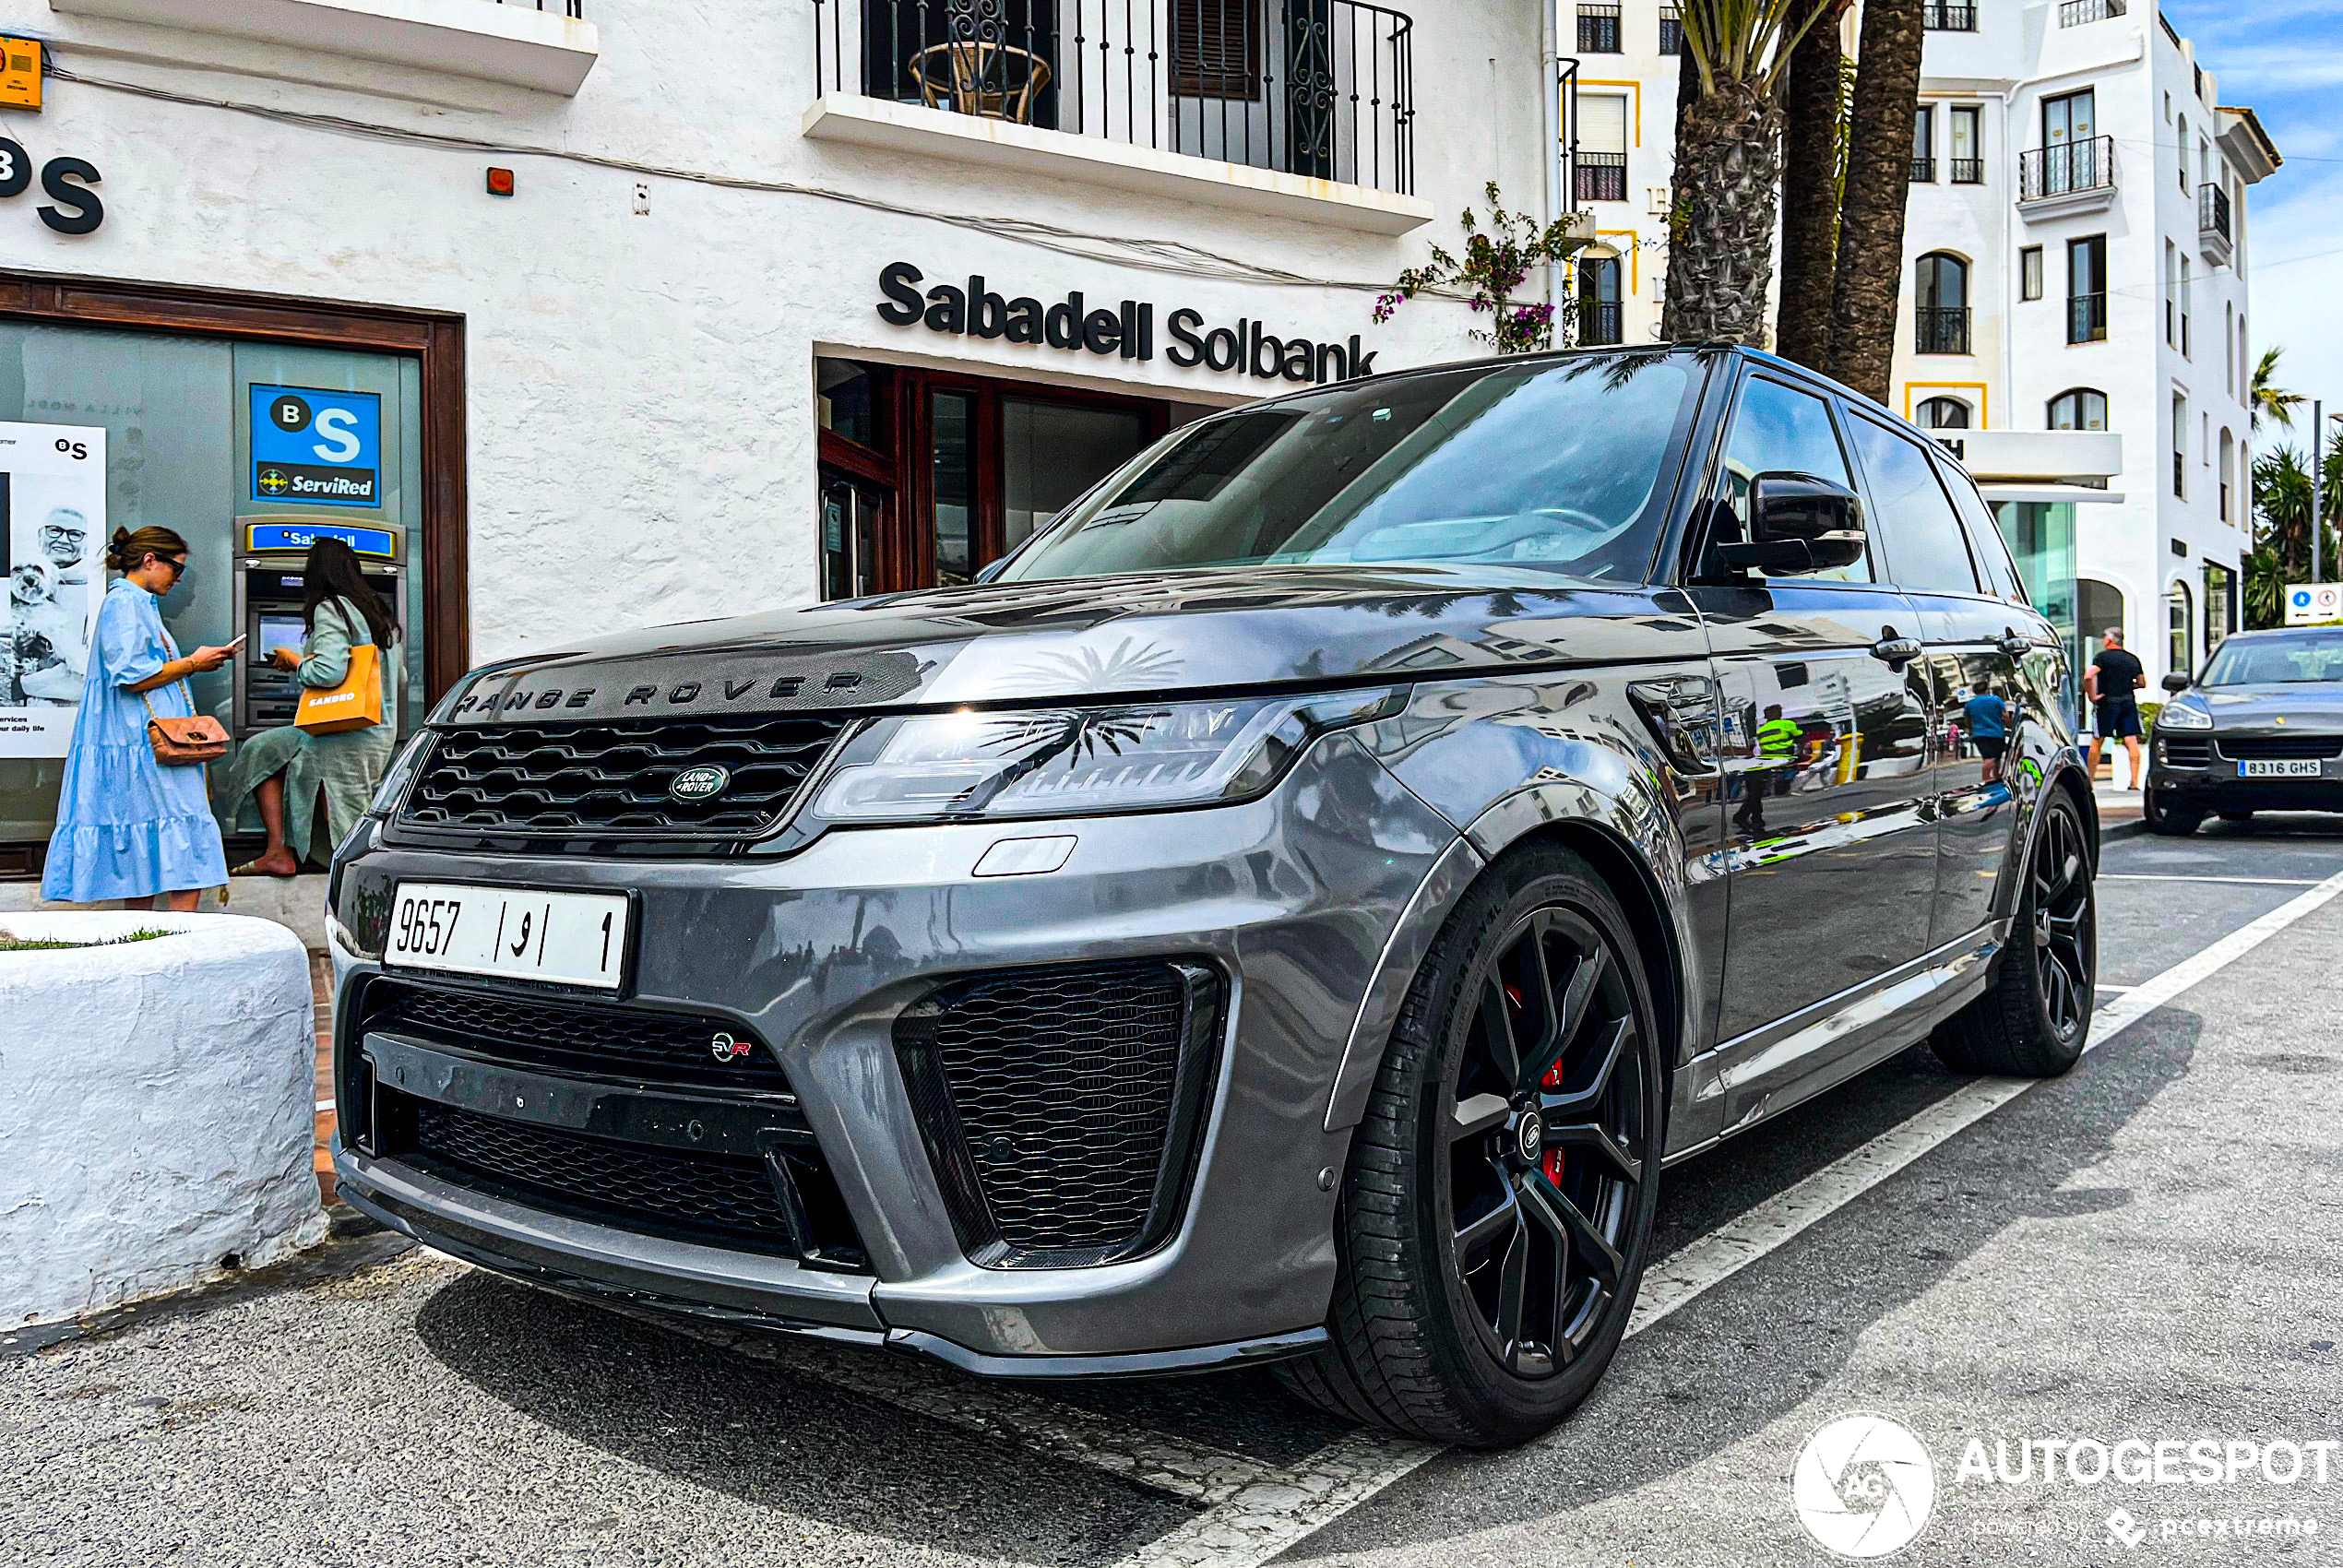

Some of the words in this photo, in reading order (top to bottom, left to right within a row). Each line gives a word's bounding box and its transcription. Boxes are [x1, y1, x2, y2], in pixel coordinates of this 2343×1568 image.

[876, 261, 1153, 361] Sabadell
[1165, 308, 1378, 385] Solbank
[291, 475, 372, 496] ServiRed
[309, 693, 355, 707] SANDRO
[456, 687, 596, 714] RANGE
[624, 671, 863, 707] ROVER
[681, 772, 710, 782] LAND
[2249, 763, 2285, 775] 8316
[2289, 762, 2317, 775] GHS
[679, 781, 715, 792] ROVER
[397, 898, 461, 956] 9657
